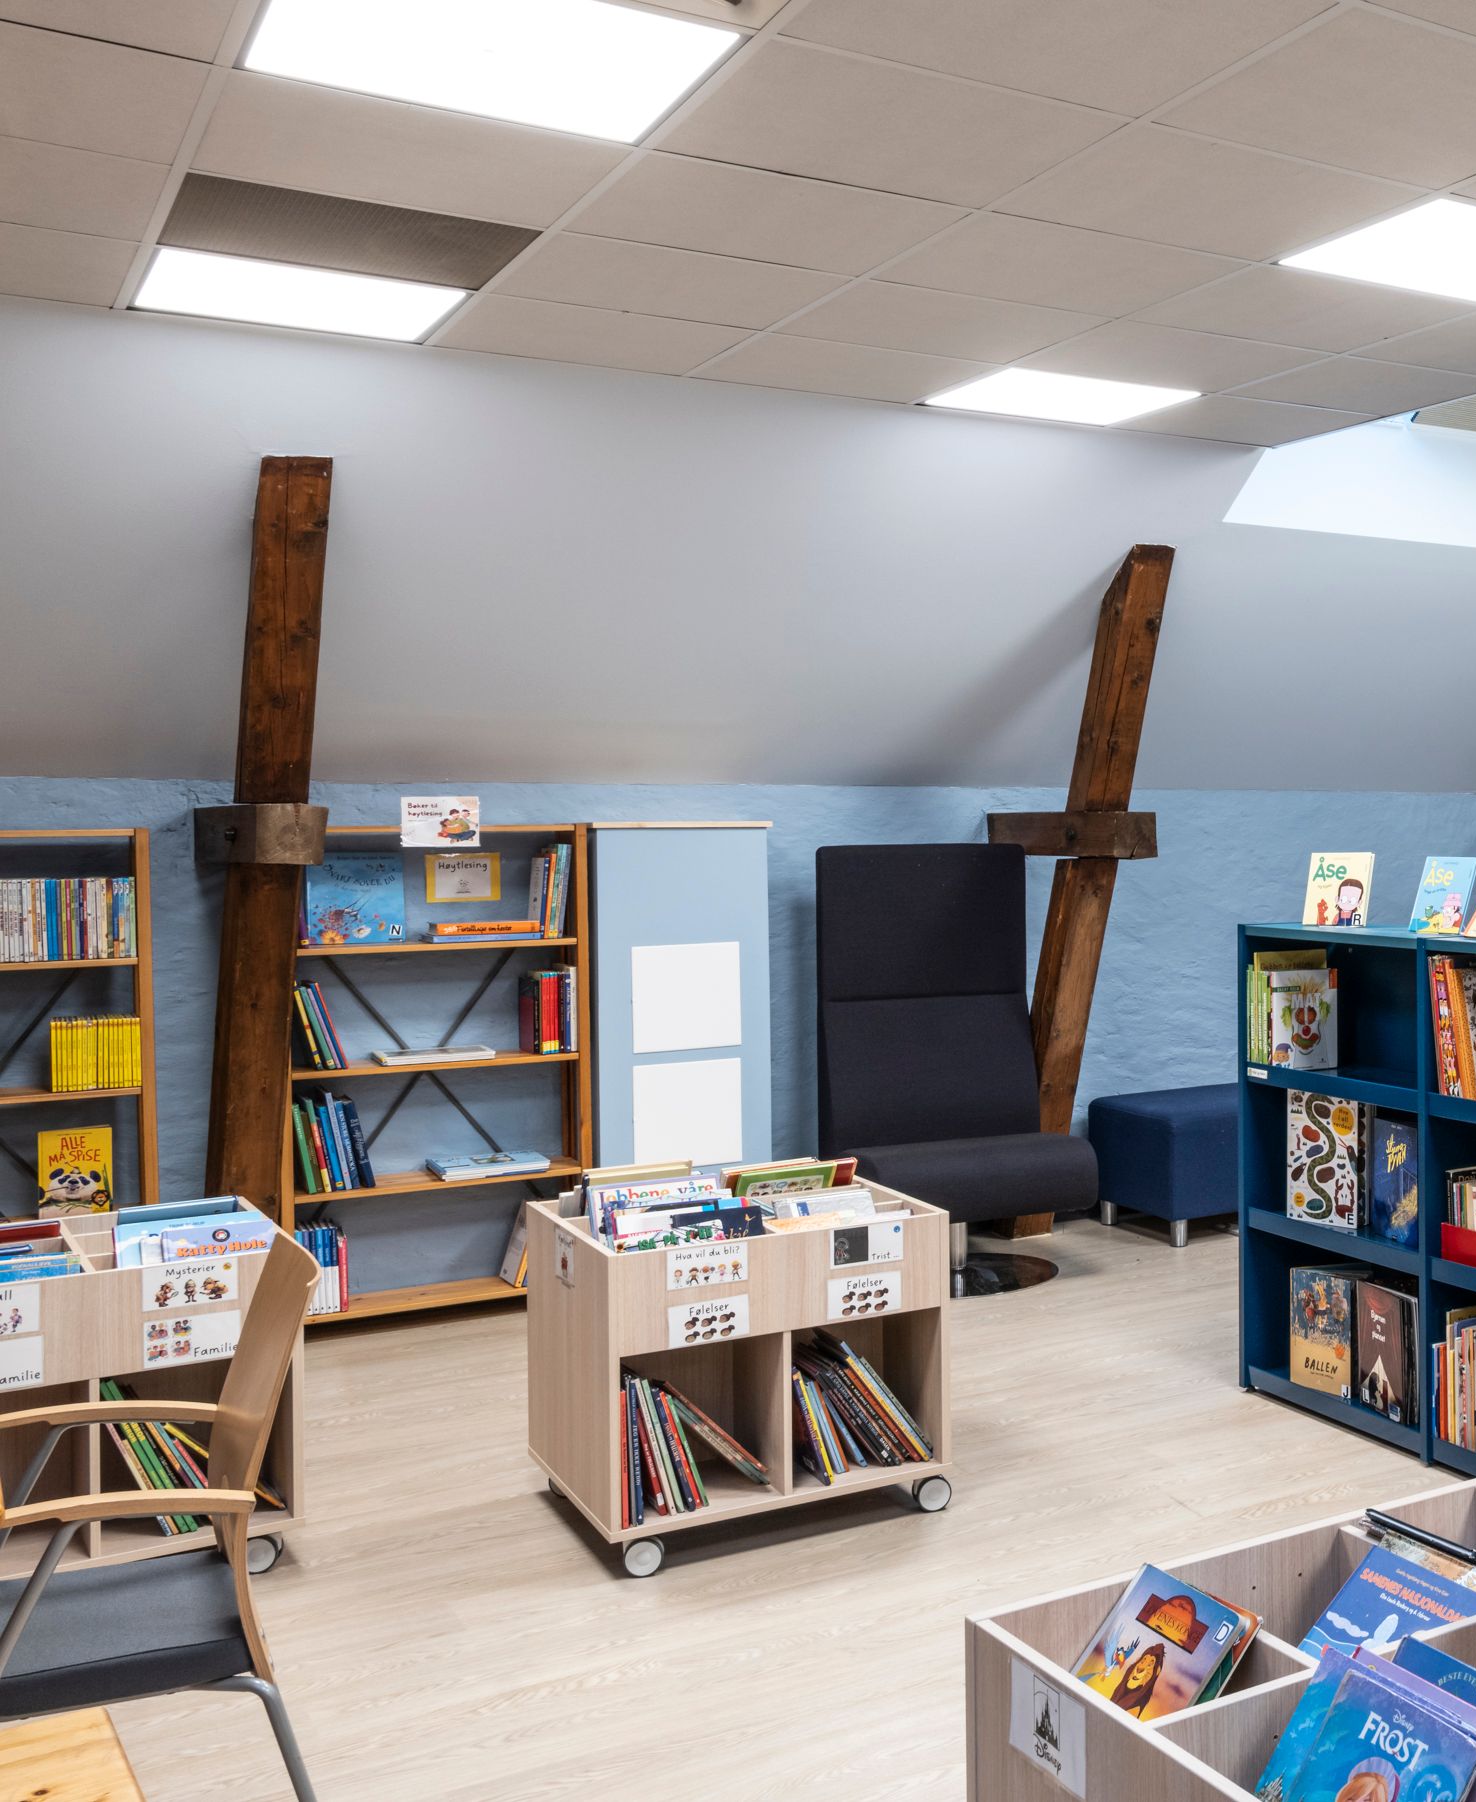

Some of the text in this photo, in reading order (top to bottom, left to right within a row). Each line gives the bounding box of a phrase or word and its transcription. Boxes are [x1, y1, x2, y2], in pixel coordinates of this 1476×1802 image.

[408, 810, 443, 818] høytlesing
[438, 861, 488, 873] Høytlesing
[1313, 856, 1347, 882] Åse
[1424, 860, 1454, 886] Åse
[1353, 914, 1362, 925] R
[391, 925, 400, 935] N
[61, 1136, 86, 1151] ALLE
[48, 1149, 101, 1167] MÅ SPISE
[598, 1181, 714, 1210] Jobbene våre
[1347, 1213, 1354, 1225] E
[675, 1245, 740, 1261] Hva vil du bli?
[872, 1252, 891, 1260] Trist
[165, 1264, 216, 1280] Mysterier
[847, 1278, 884, 1290] Følelser
[689, 1303, 729, 1317] Følelser
[193, 1342, 239, 1358] Familie
[1304, 1357, 1339, 1375] BALLEN
[0, 1370, 41, 1384] amilie
[1343, 1386, 1349, 1399] J
[1214, 1623, 1230, 1642] D
[1437, 1671, 1462, 1687] BESTE
[1393, 1708, 1415, 1734] Disney
[1358, 1711, 1429, 1772] FROST
[1033, 1733, 1062, 1776] Disney
